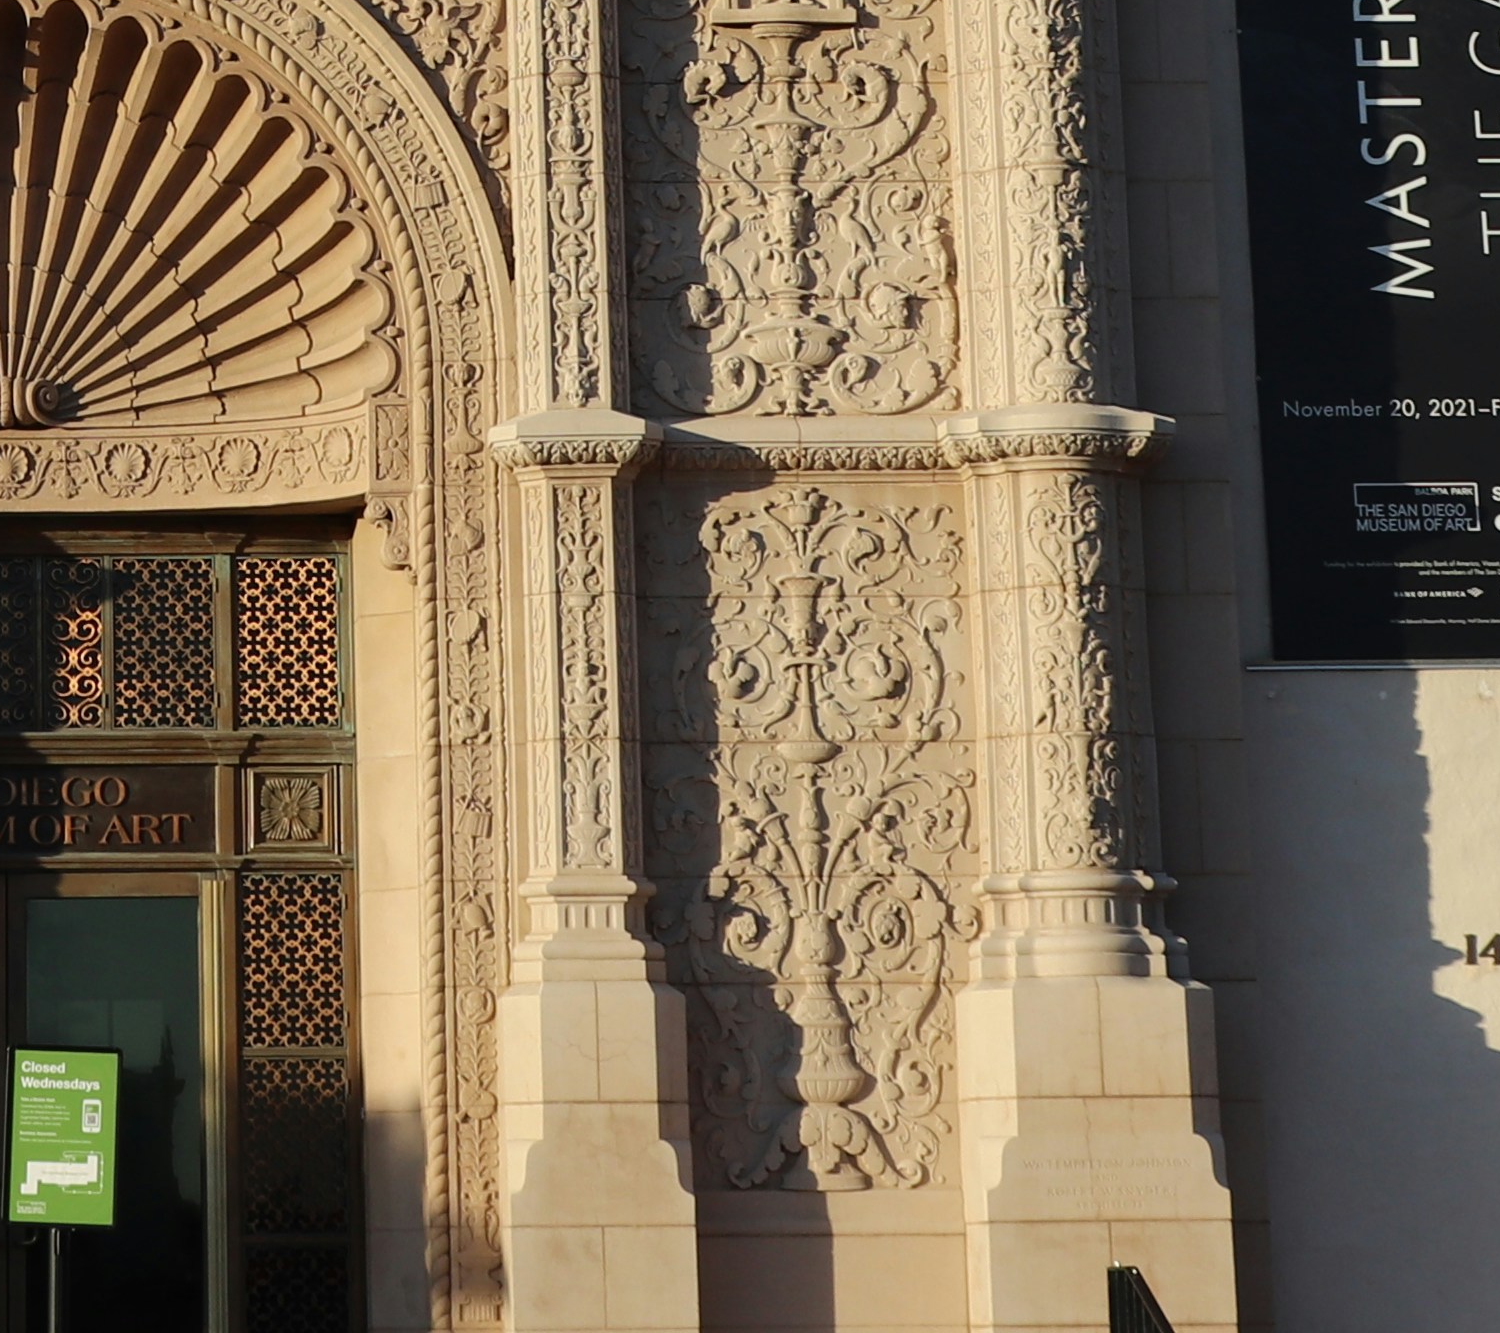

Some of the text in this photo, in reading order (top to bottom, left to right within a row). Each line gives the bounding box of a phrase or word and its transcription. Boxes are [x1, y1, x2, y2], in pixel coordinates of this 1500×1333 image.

[1283, 399, 1382, 417] November
[1390, 399, 1421, 421] 20,
[1358, 504, 1466, 517] THE SAN DIEGO
[1356, 518, 1473, 532] MUSEUM OF ART
[29, 813, 93, 846] OF
[98, 813, 194, 846] ART
[21, 1060, 66, 1074] Closed
[20, 1076, 100, 1093] Wednesdays
